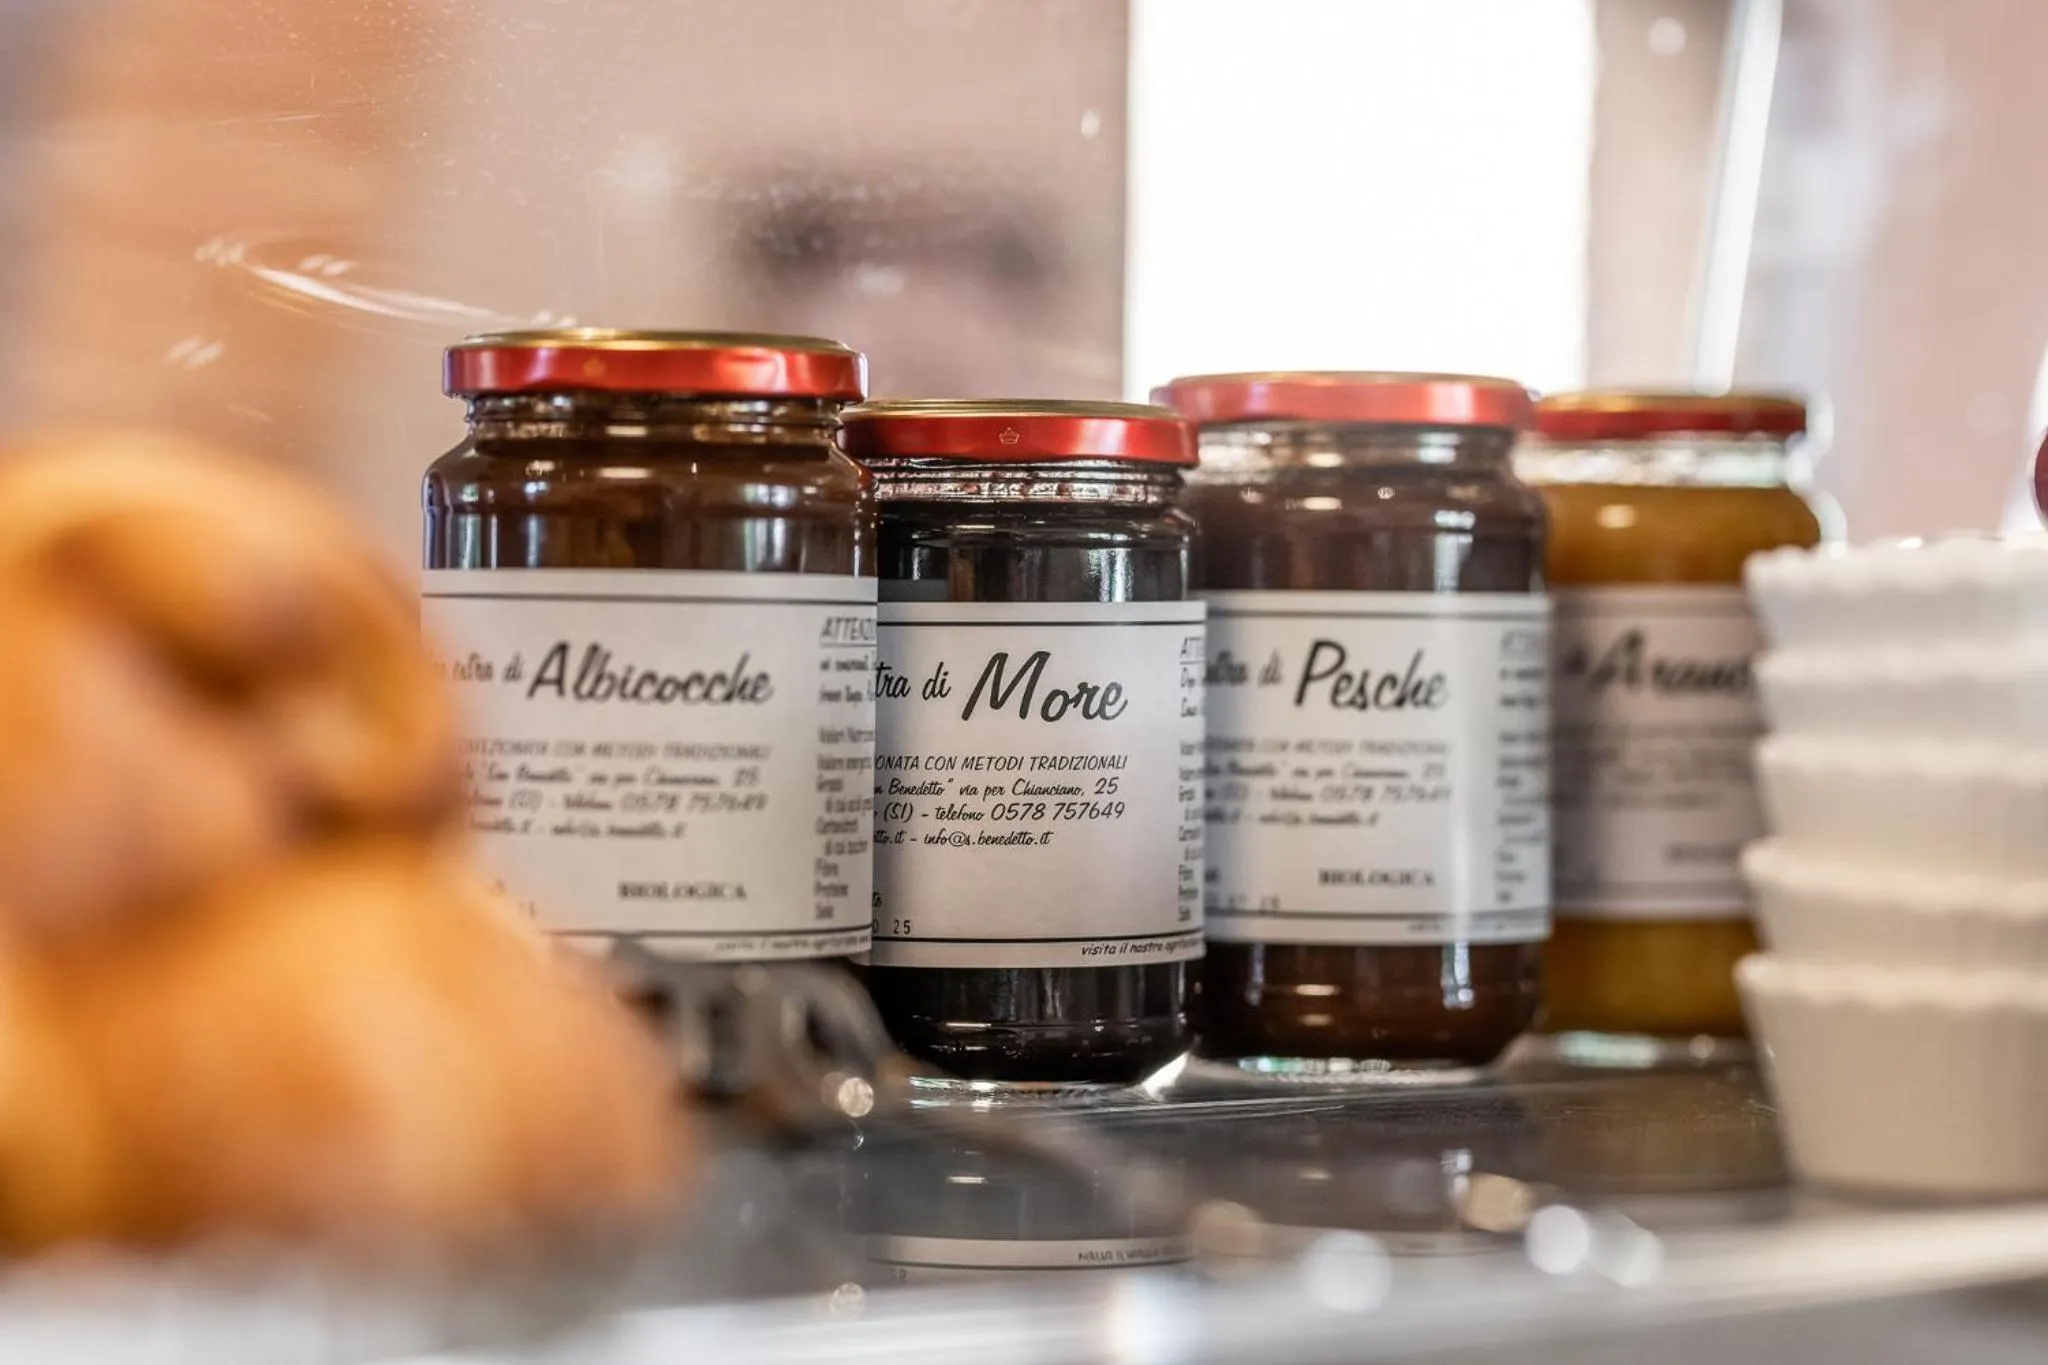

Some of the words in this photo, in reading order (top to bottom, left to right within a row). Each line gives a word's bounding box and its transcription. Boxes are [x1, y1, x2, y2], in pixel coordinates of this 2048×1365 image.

[525, 640, 776, 705] Albicocche
[1293, 638, 1448, 711] Pesche
[922, 661, 951, 701] di
[961, 650, 1128, 723] More
[924, 755, 958, 771] CON
[960, 755, 1024, 772] METODI
[1030, 755, 1128, 771] TRADIZIONALI
[959, 785, 979, 797] via
[982, 785, 1006, 802] per
[1011, 778, 1085, 797] Chianciano,
[1094, 776, 1120, 795] 25
[883, 802, 914, 823] (SI)
[935, 803, 984, 821] telefono
[991, 802, 1047, 821] 0578
[1052, 801, 1126, 821] 757649
[924, 827, 1054, 847] info@s.benedetto.it
[1081, 943, 1117, 956] visita
[1119, 942, 1129, 954] il
